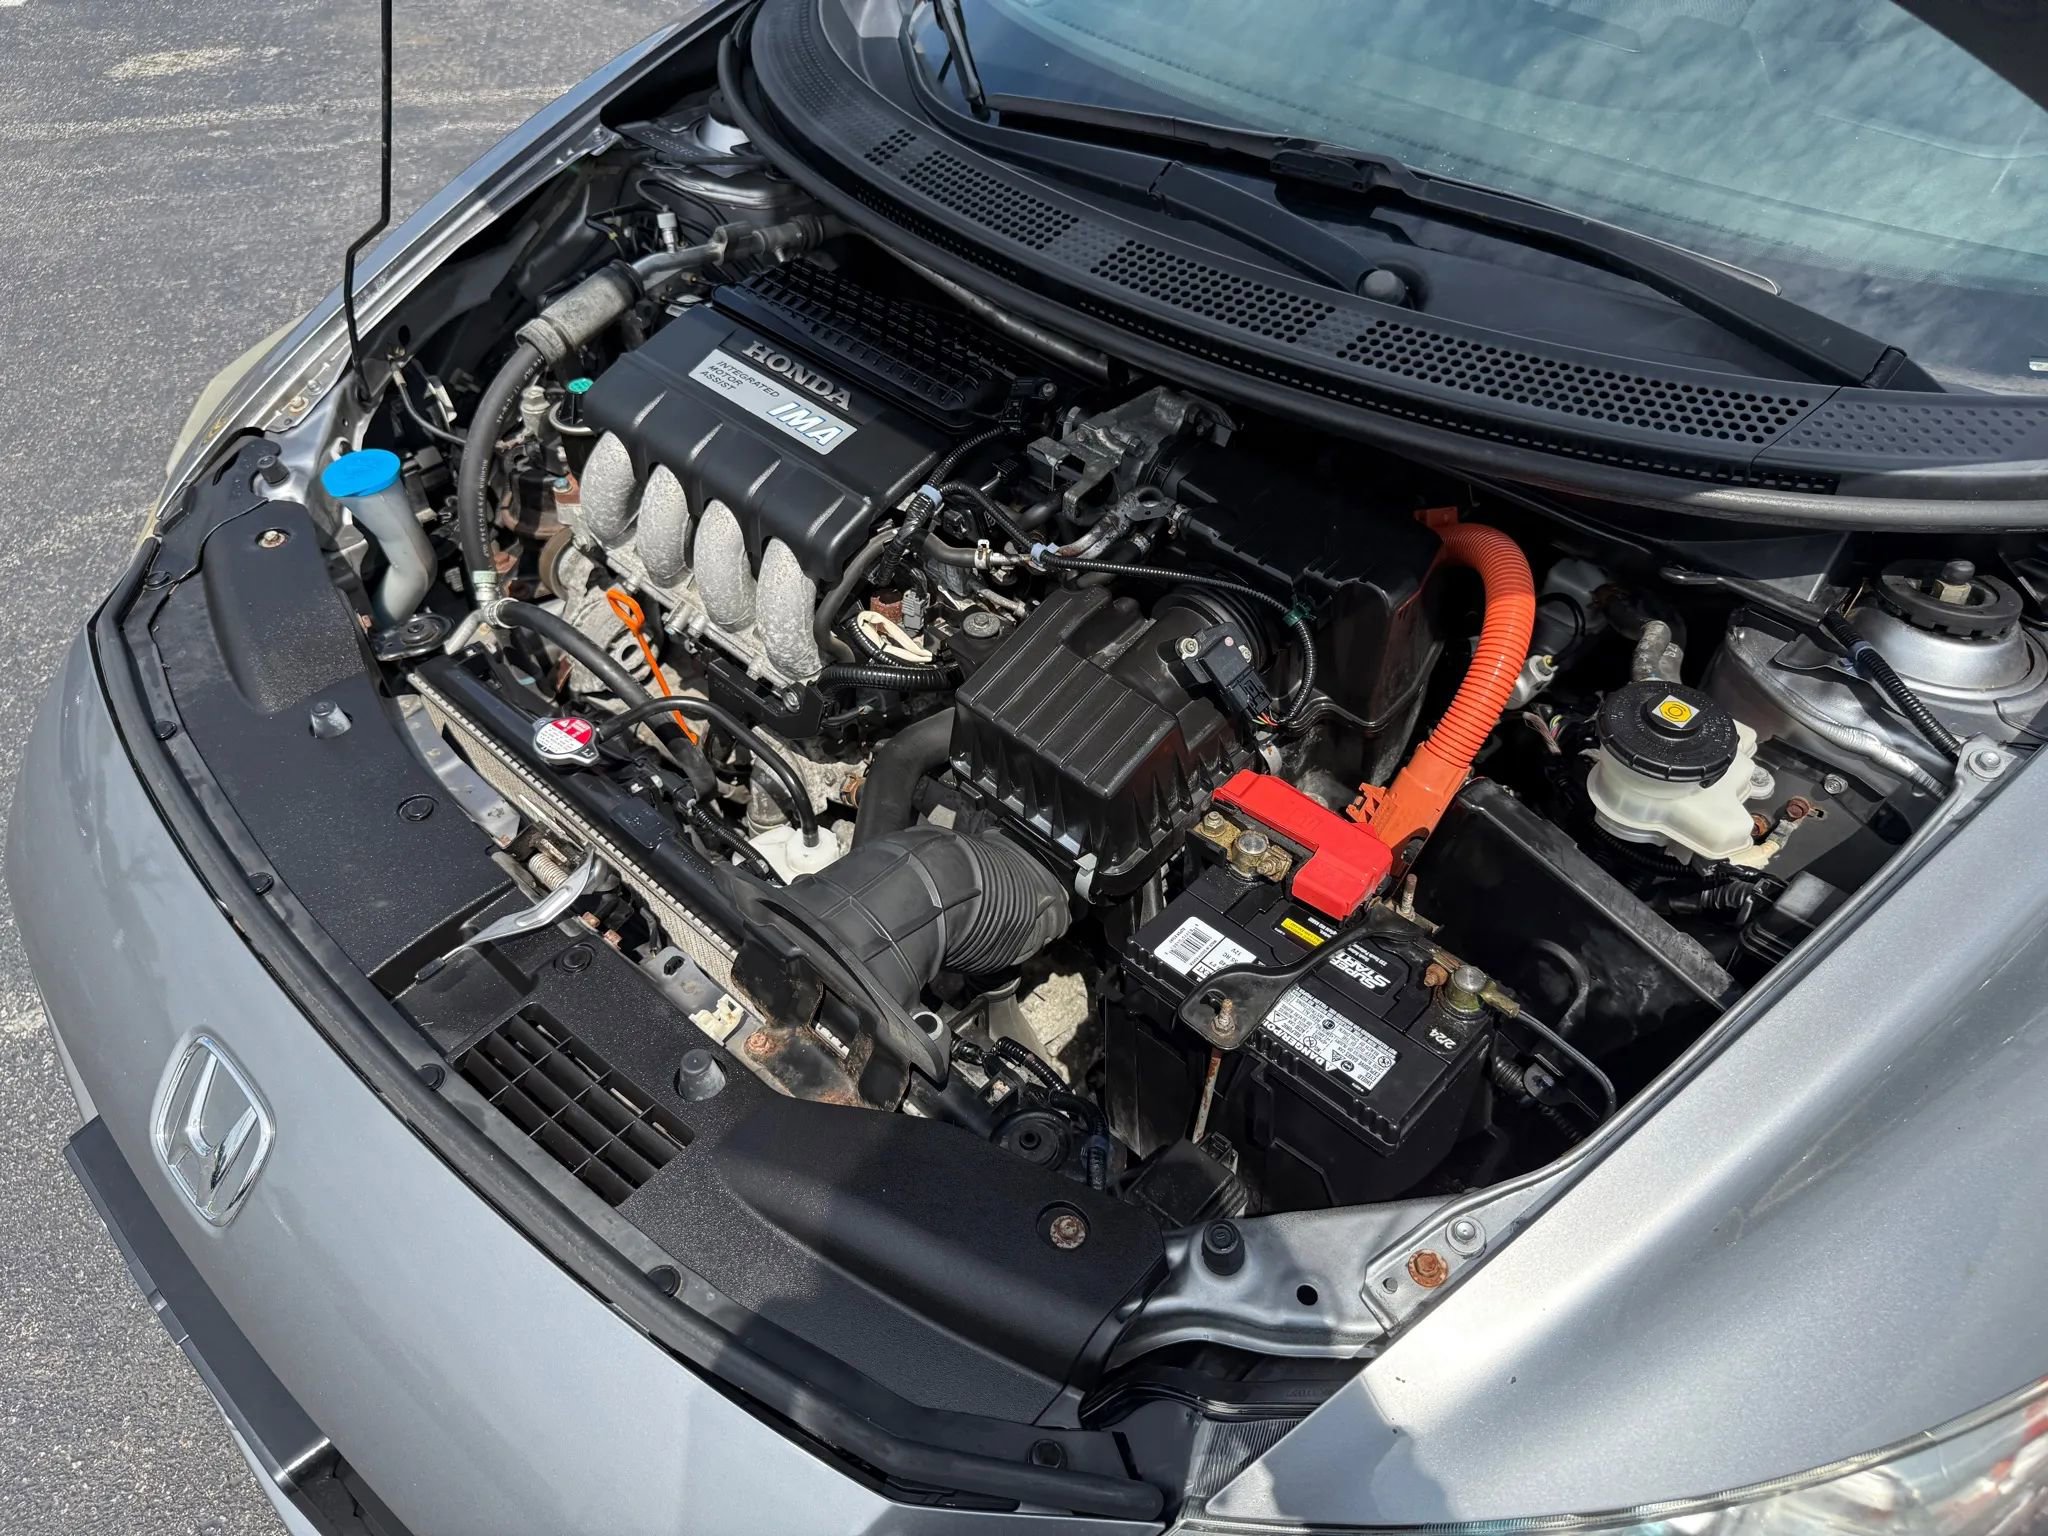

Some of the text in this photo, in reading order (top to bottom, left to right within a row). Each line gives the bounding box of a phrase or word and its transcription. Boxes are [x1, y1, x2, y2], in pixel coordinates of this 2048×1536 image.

[700, 370, 737, 391] ASSIST
[707, 365, 744, 387] MOTOR
[716, 361, 781, 398] INTEGRATED
[741, 340, 853, 411] HONDA
[766, 401, 844, 447] IMA
[1230, 947, 1241, 955] 12V
[1426, 1027, 1457, 1049] 2/24
